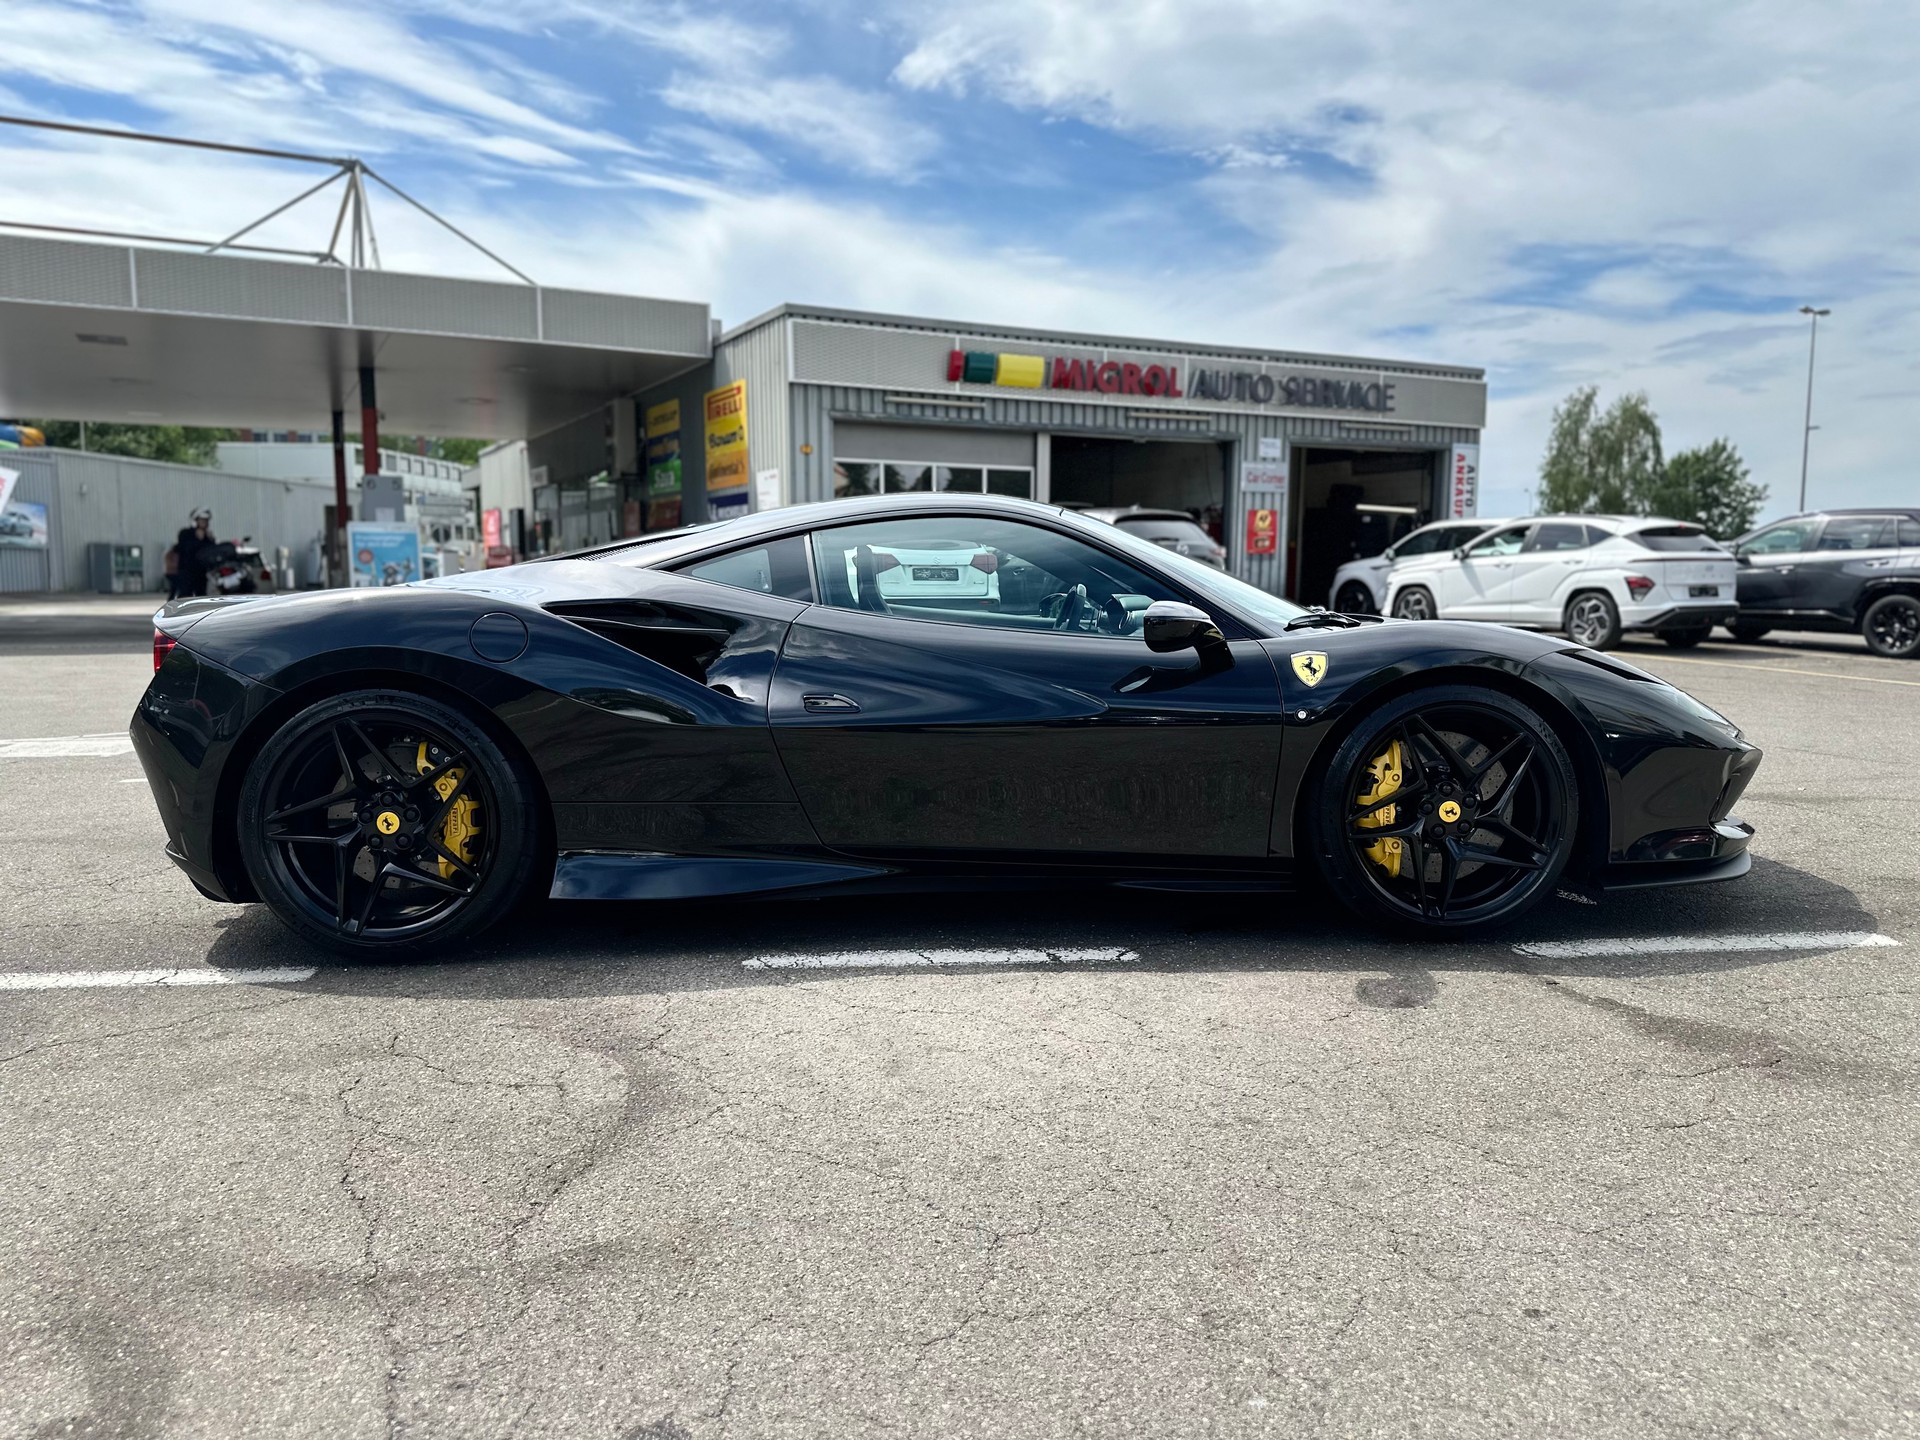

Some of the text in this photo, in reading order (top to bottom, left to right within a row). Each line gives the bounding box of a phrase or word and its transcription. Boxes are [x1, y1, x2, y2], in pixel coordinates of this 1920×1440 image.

[1052, 356, 1396, 412] MIGROL AUTO SERVICE
[1454, 453, 1466, 518] ANKAUF
[1464, 465, 1476, 507] AUTO
